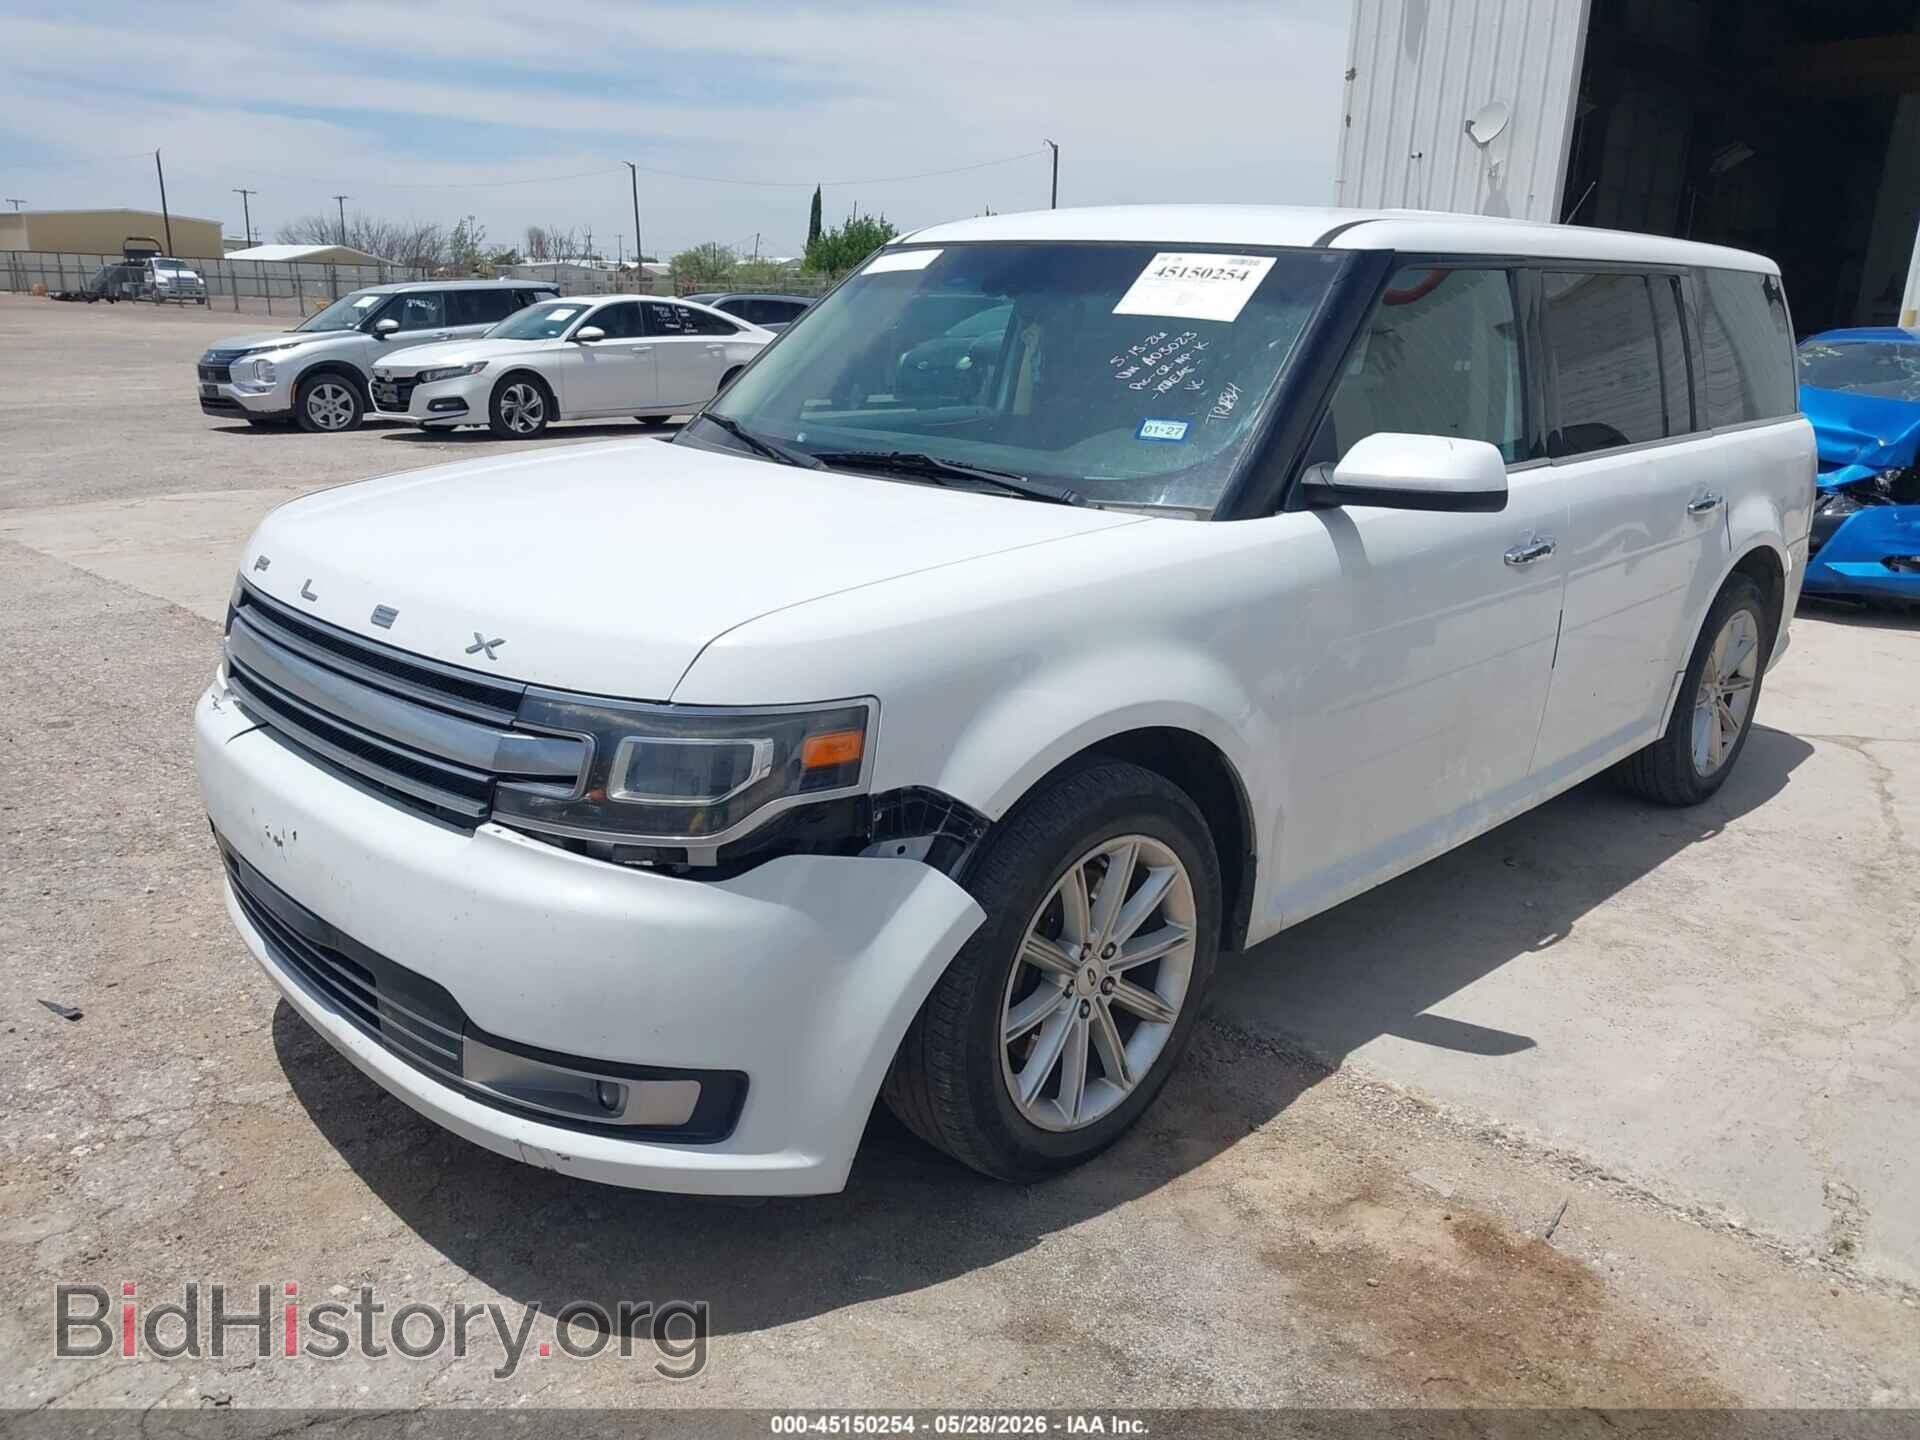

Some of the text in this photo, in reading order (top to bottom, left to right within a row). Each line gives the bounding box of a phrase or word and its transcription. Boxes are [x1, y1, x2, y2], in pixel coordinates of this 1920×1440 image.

[1154, 264, 1250, 282] 45150254
[1143, 424, 1184, 437] 01-27
[253, 554, 507, 662] FLEX
